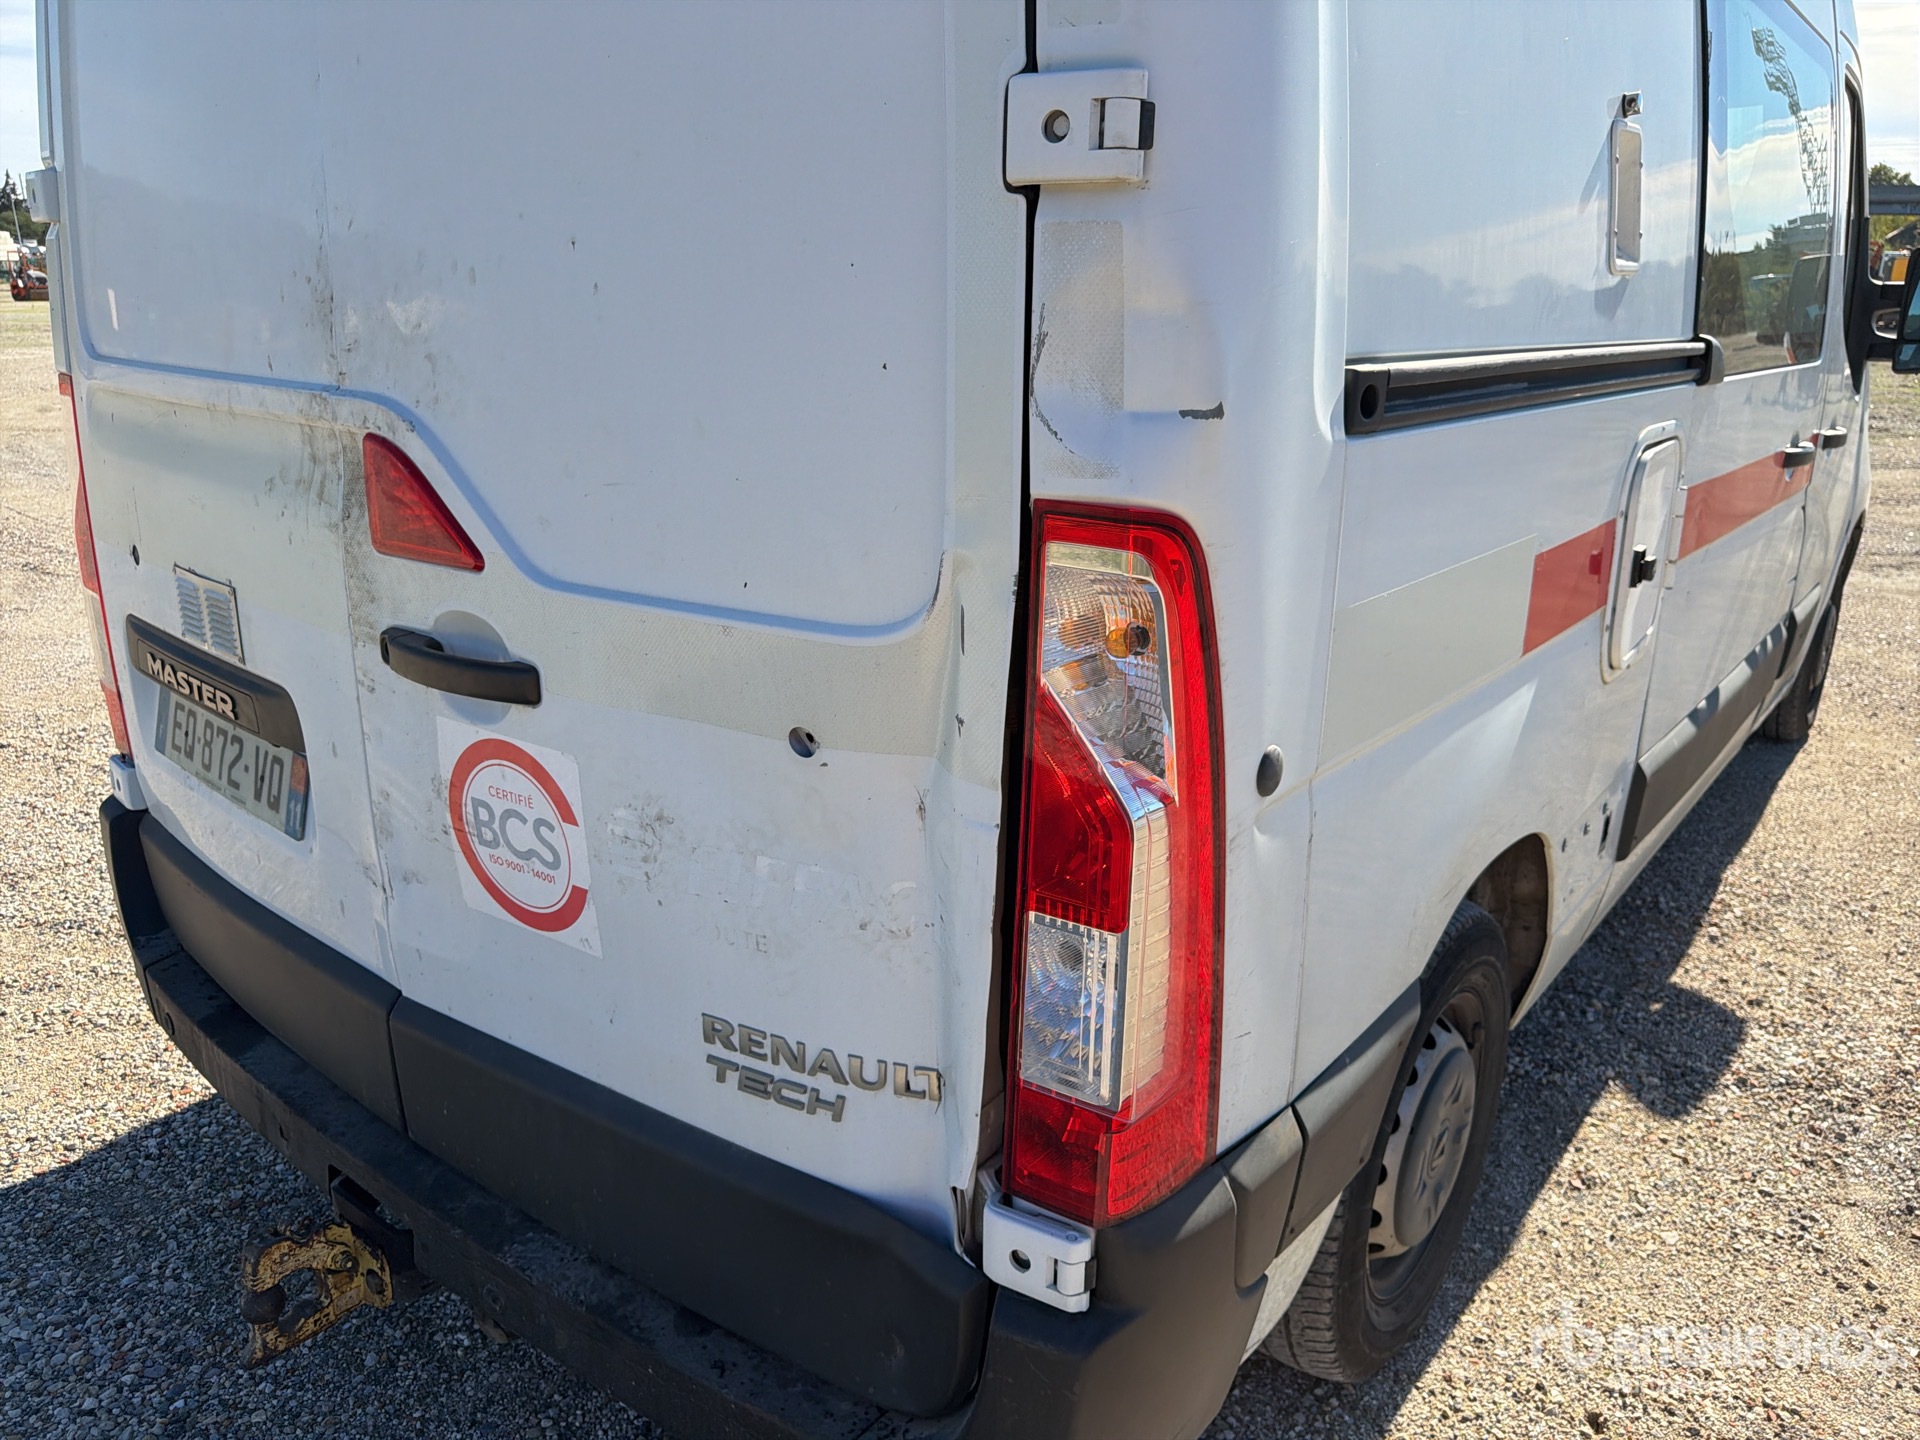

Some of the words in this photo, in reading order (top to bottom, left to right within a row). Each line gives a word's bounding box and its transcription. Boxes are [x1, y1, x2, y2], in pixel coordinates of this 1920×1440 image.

[146, 652, 237, 720] MASTER
[171, 703, 285, 814] EQ-872-VQ
[289, 798, 302, 830] 11
[488, 785, 534, 809] CERTIFIÉ
[471, 796, 562, 871] BCS
[489, 853, 504, 867] ISO
[505, 857, 525, 875] 9001
[531, 867, 556, 885] 14001
[701, 1012, 943, 1102] RENAULT
[706, 1054, 847, 1123] TECH
